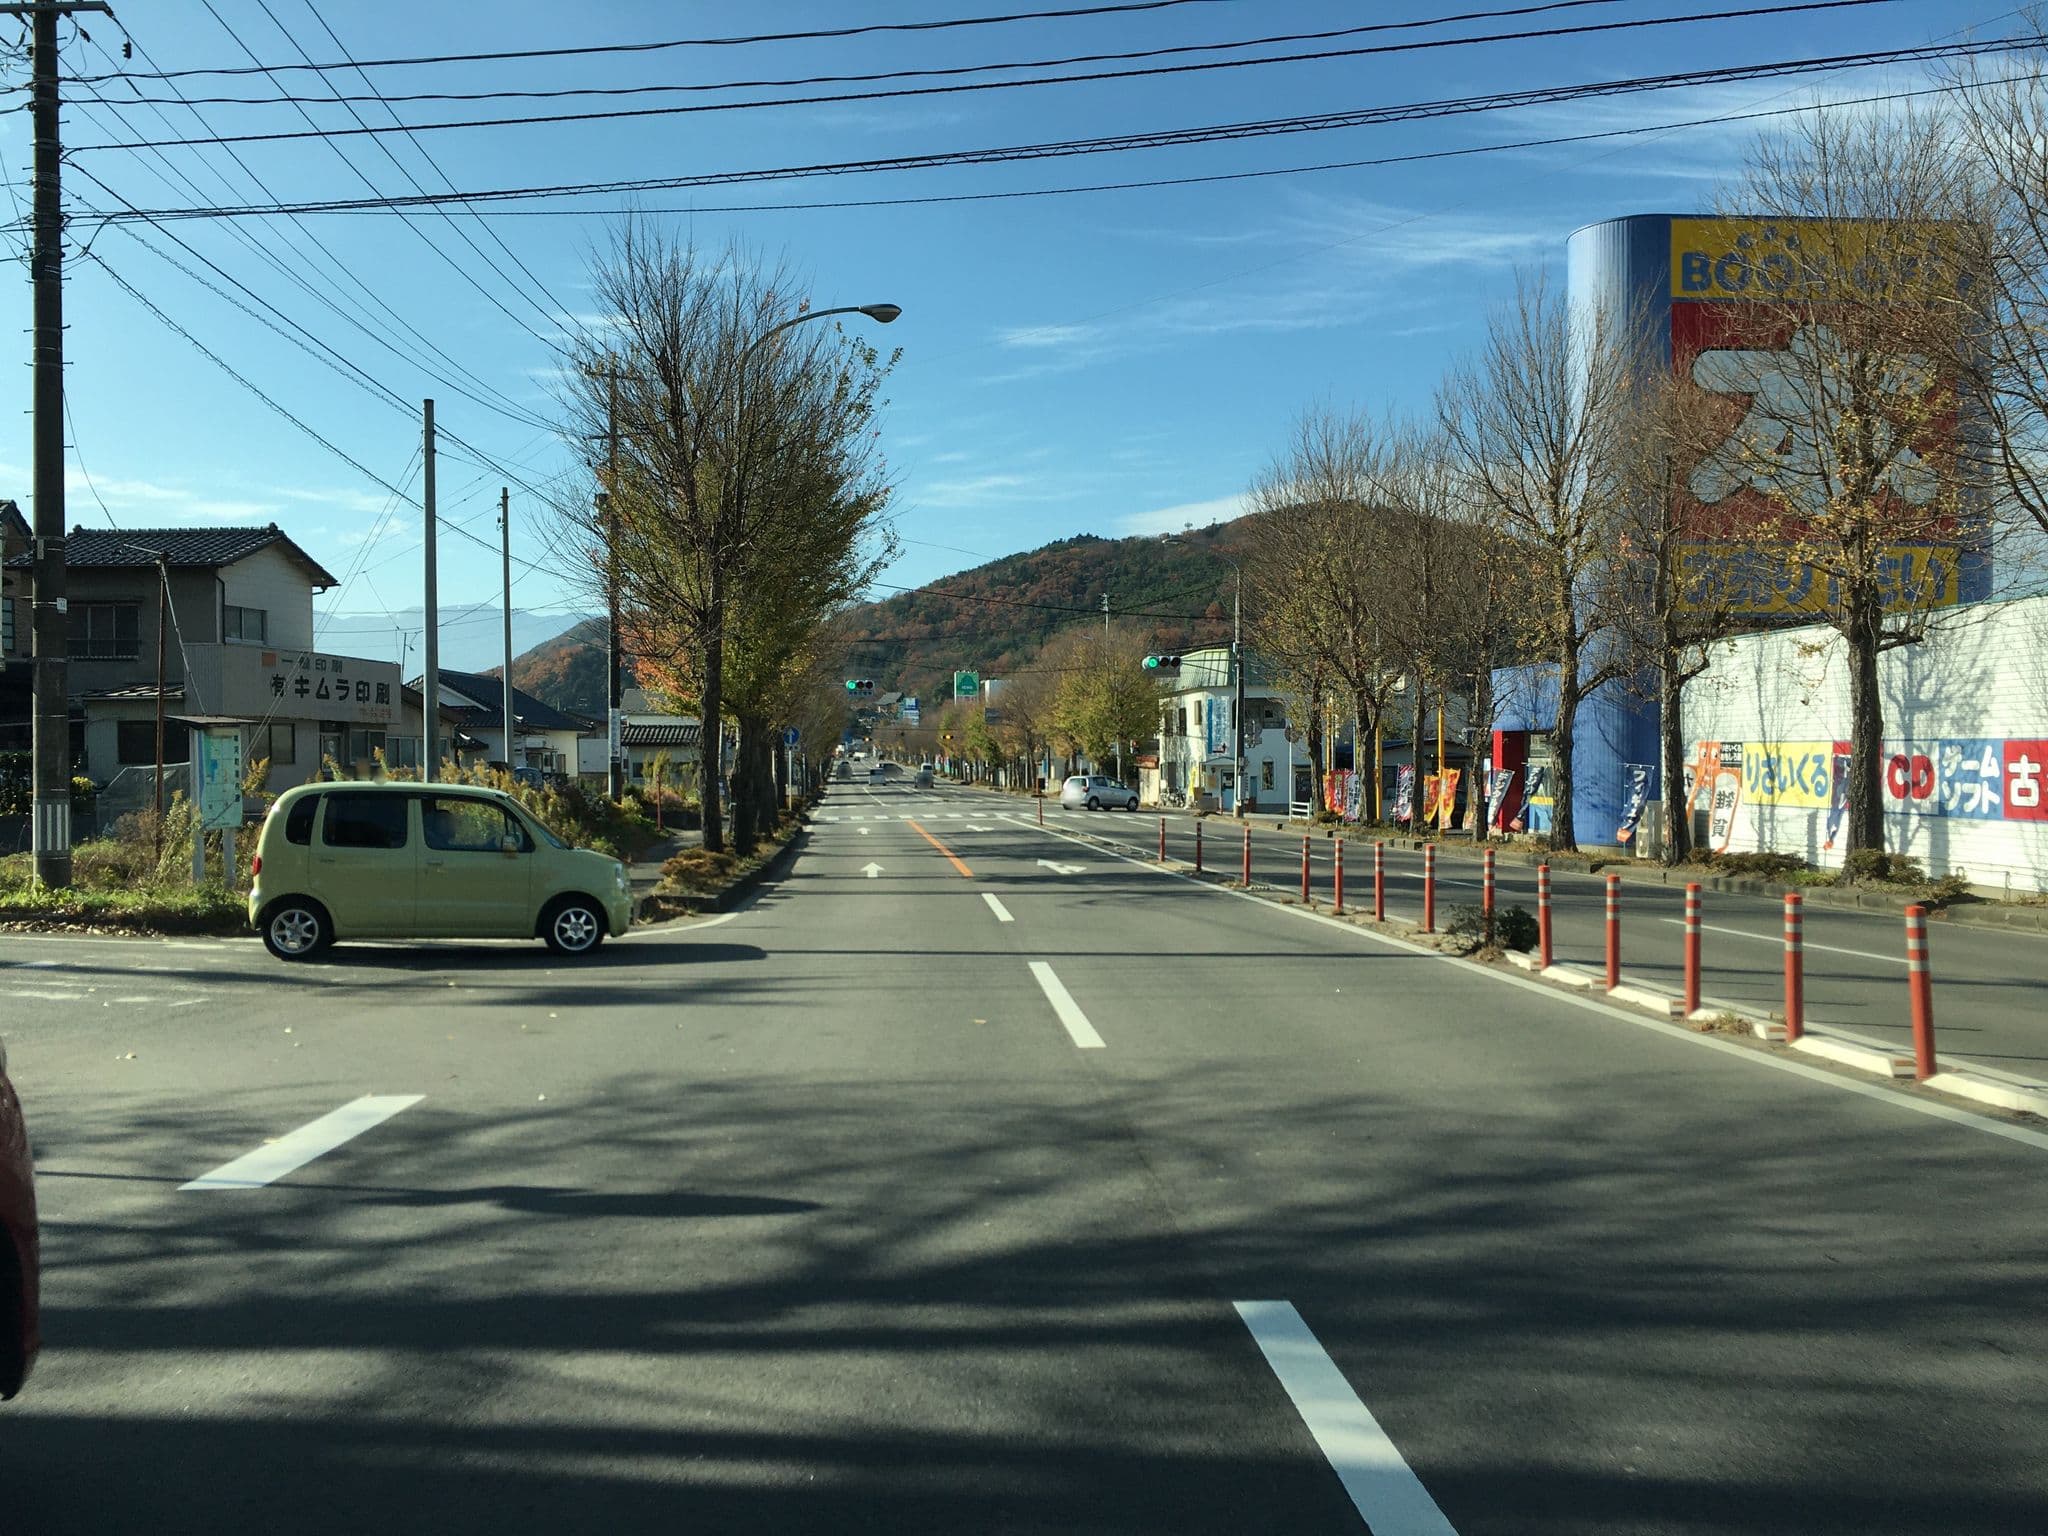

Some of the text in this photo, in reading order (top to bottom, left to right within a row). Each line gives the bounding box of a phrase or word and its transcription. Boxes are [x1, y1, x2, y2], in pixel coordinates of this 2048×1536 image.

[1745, 752, 1829, 798] りさいくる
[1887, 754, 1936, 800] CD
[1941, 744, 2000, 778] ゲーム
[2008, 754, 2048, 807] 古
[1941, 780, 2000, 814] ソフト
